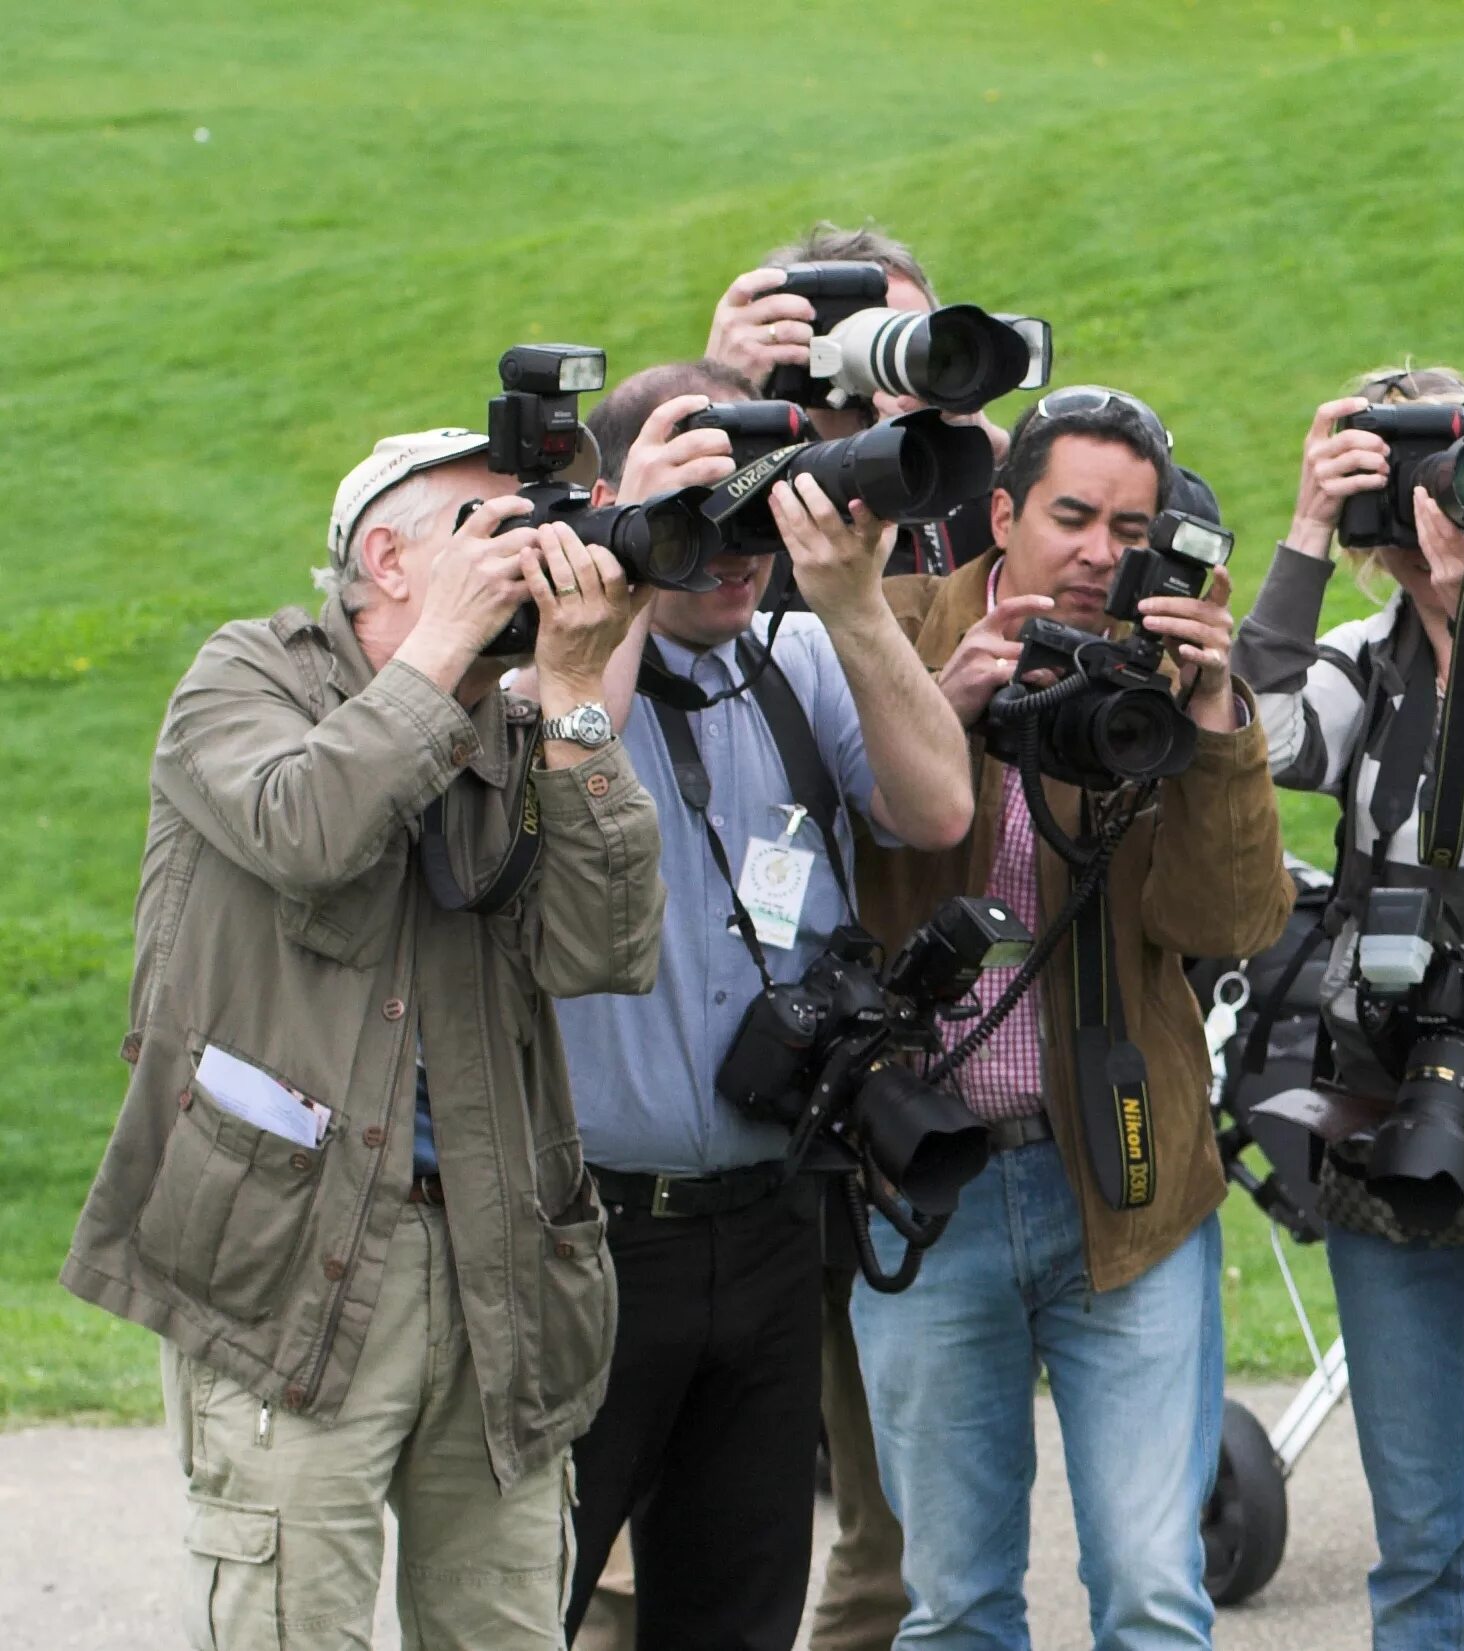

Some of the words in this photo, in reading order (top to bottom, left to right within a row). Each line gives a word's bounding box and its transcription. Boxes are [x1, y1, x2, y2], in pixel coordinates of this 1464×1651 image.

[339, 447, 417, 521] ANAVERAL
[727, 460, 775, 498] D200
[1122, 1098, 1142, 1159] Nikon
